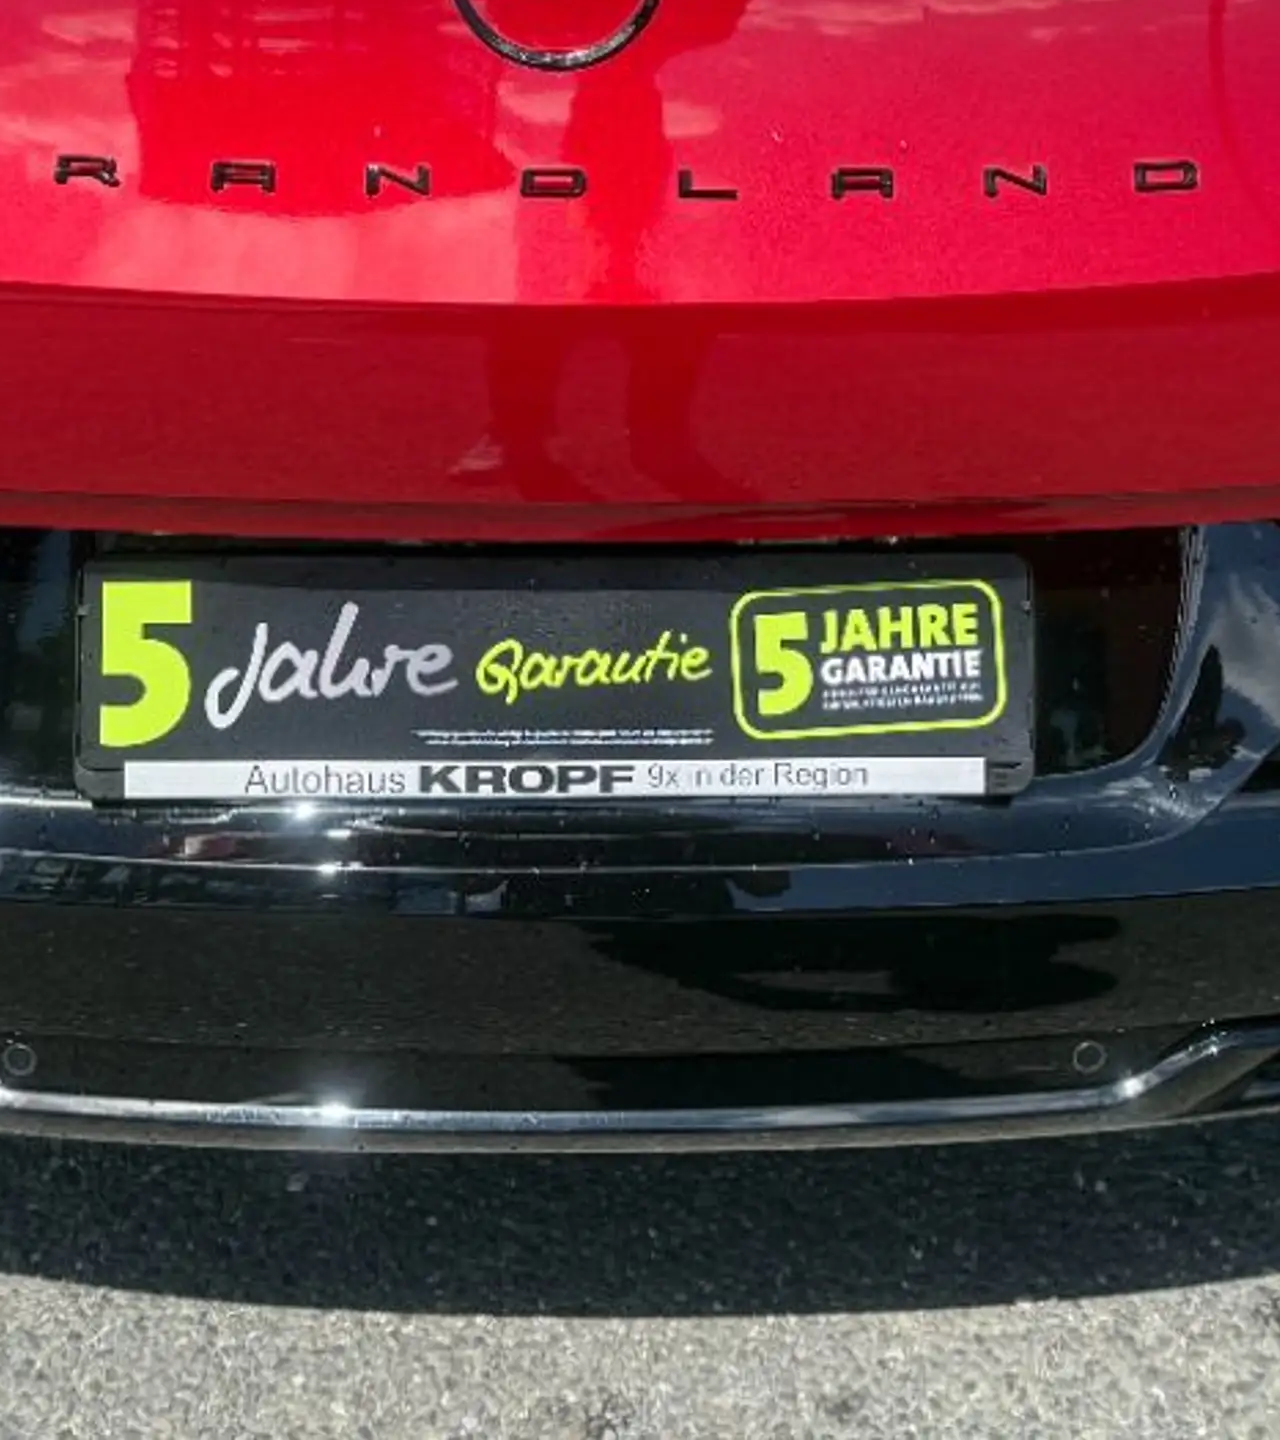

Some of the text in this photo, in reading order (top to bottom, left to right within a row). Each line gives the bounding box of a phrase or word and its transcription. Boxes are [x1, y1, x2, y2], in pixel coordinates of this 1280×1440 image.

[820, 603, 979, 654] JAHRE
[99, 580, 193, 748] 5
[204, 601, 459, 730] Jahre
[753, 611, 814, 716] 5
[821, 649, 983, 686] GARANTIE
[244, 763, 406, 795] Autohaus
[419, 763, 636, 794] KROPF
[647, 762, 680, 789] 9x
[719, 762, 765, 787] der
[773, 761, 868, 790] Region
